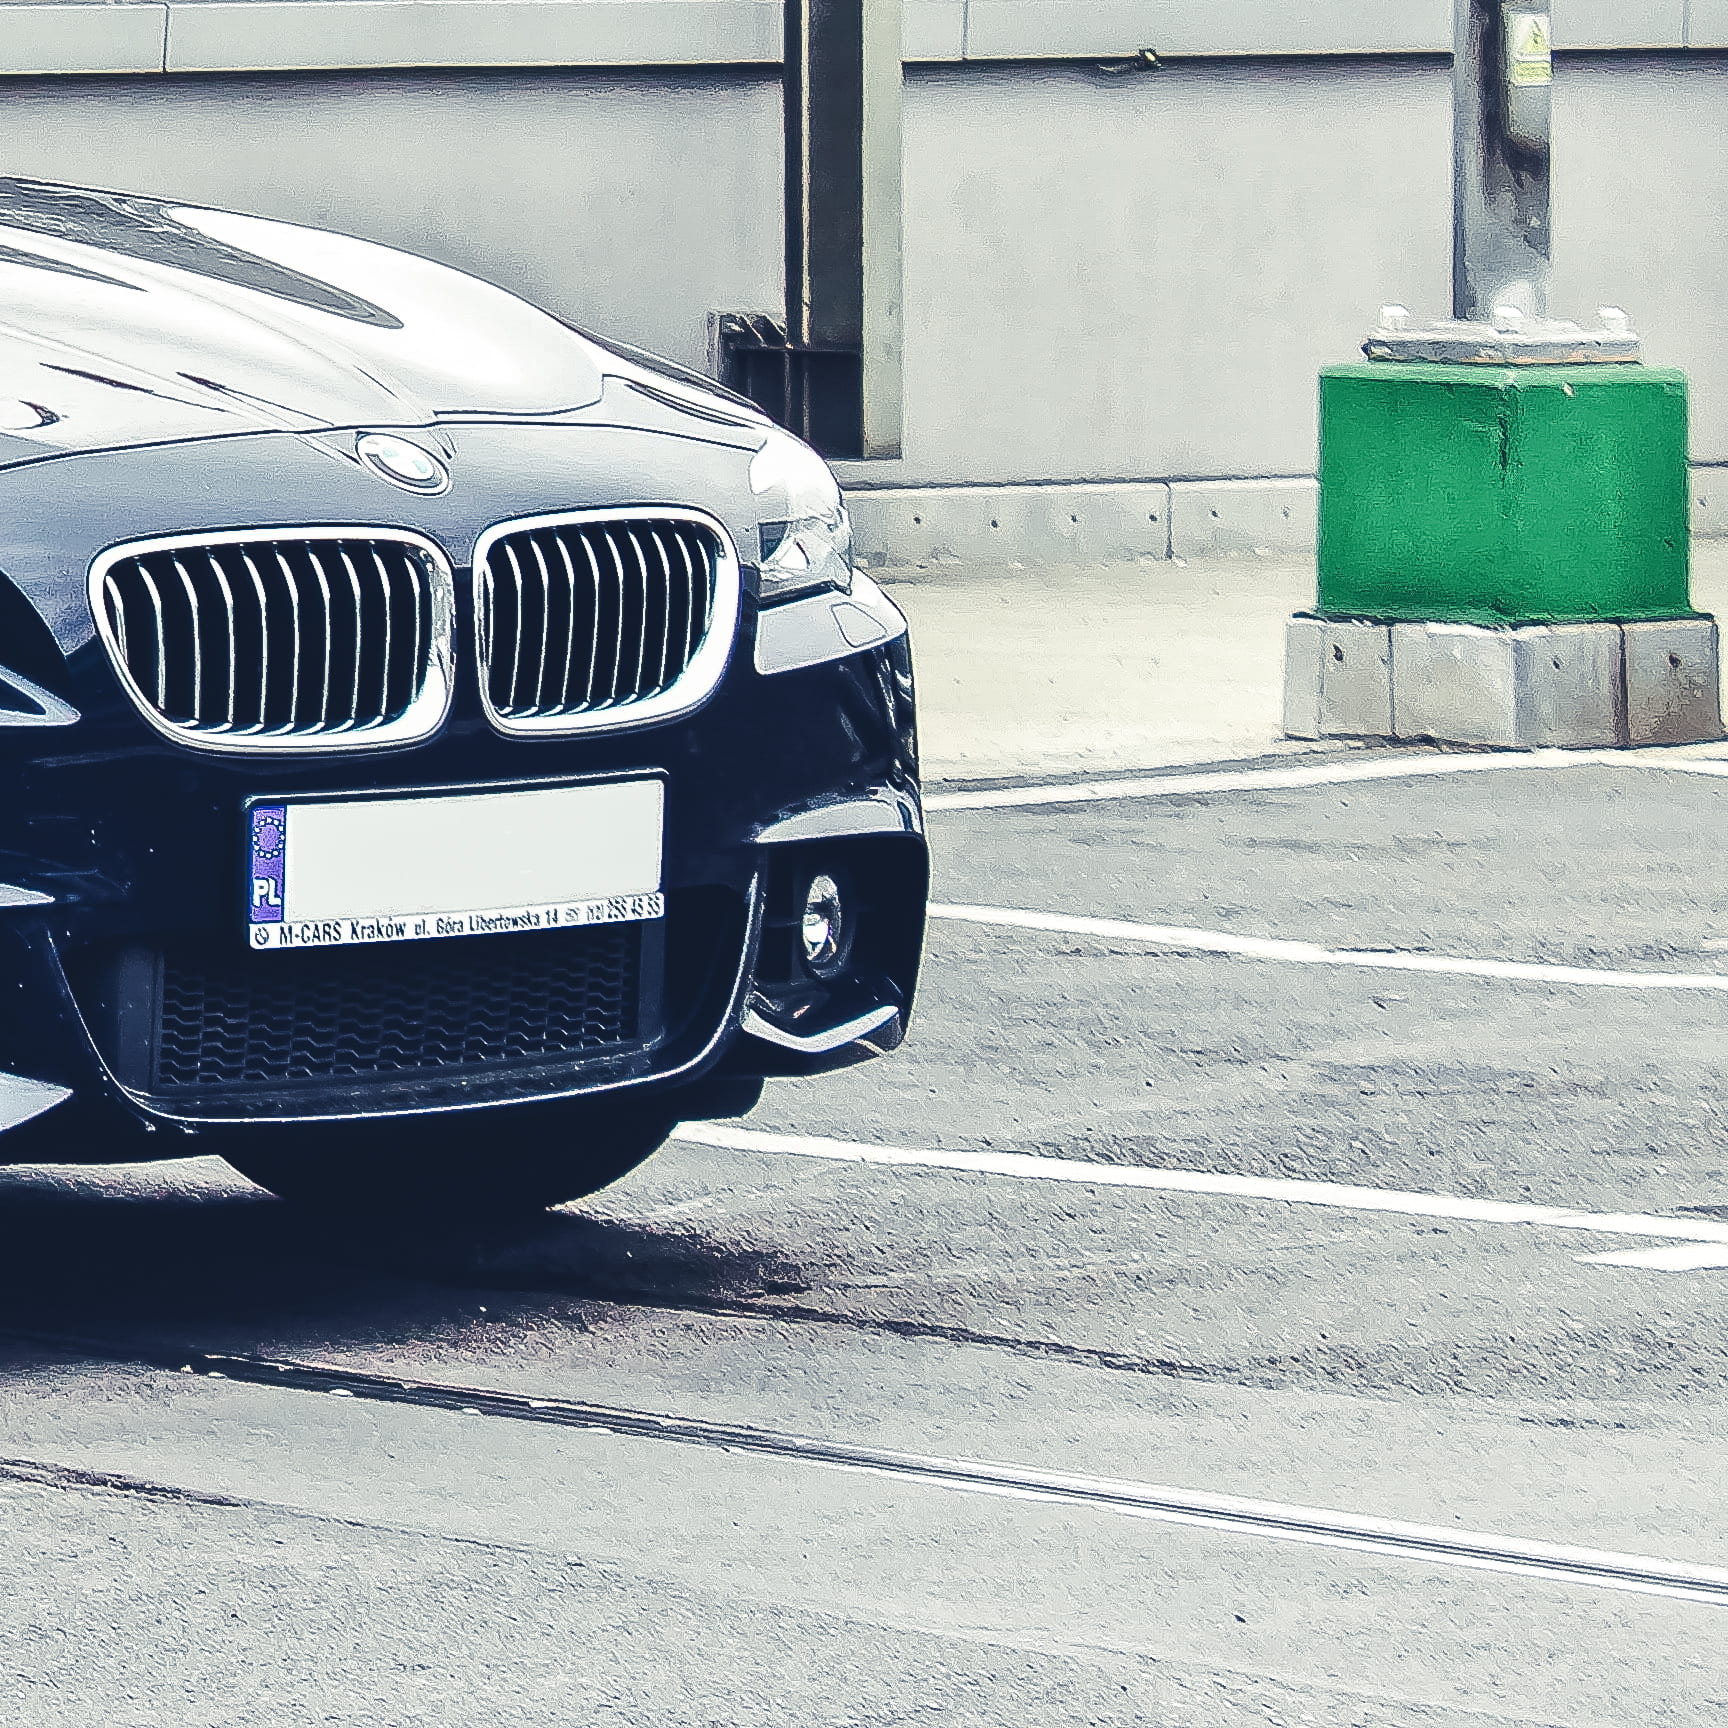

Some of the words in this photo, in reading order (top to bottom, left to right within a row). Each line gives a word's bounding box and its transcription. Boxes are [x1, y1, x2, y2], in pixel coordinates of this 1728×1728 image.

[252, 877, 282, 908] PL
[279, 921, 342, 946] M-CARS
[350, 915, 406, 941] Kraków
[414, 919, 431, 937] ul.
[436, 916, 464, 935] Góra
